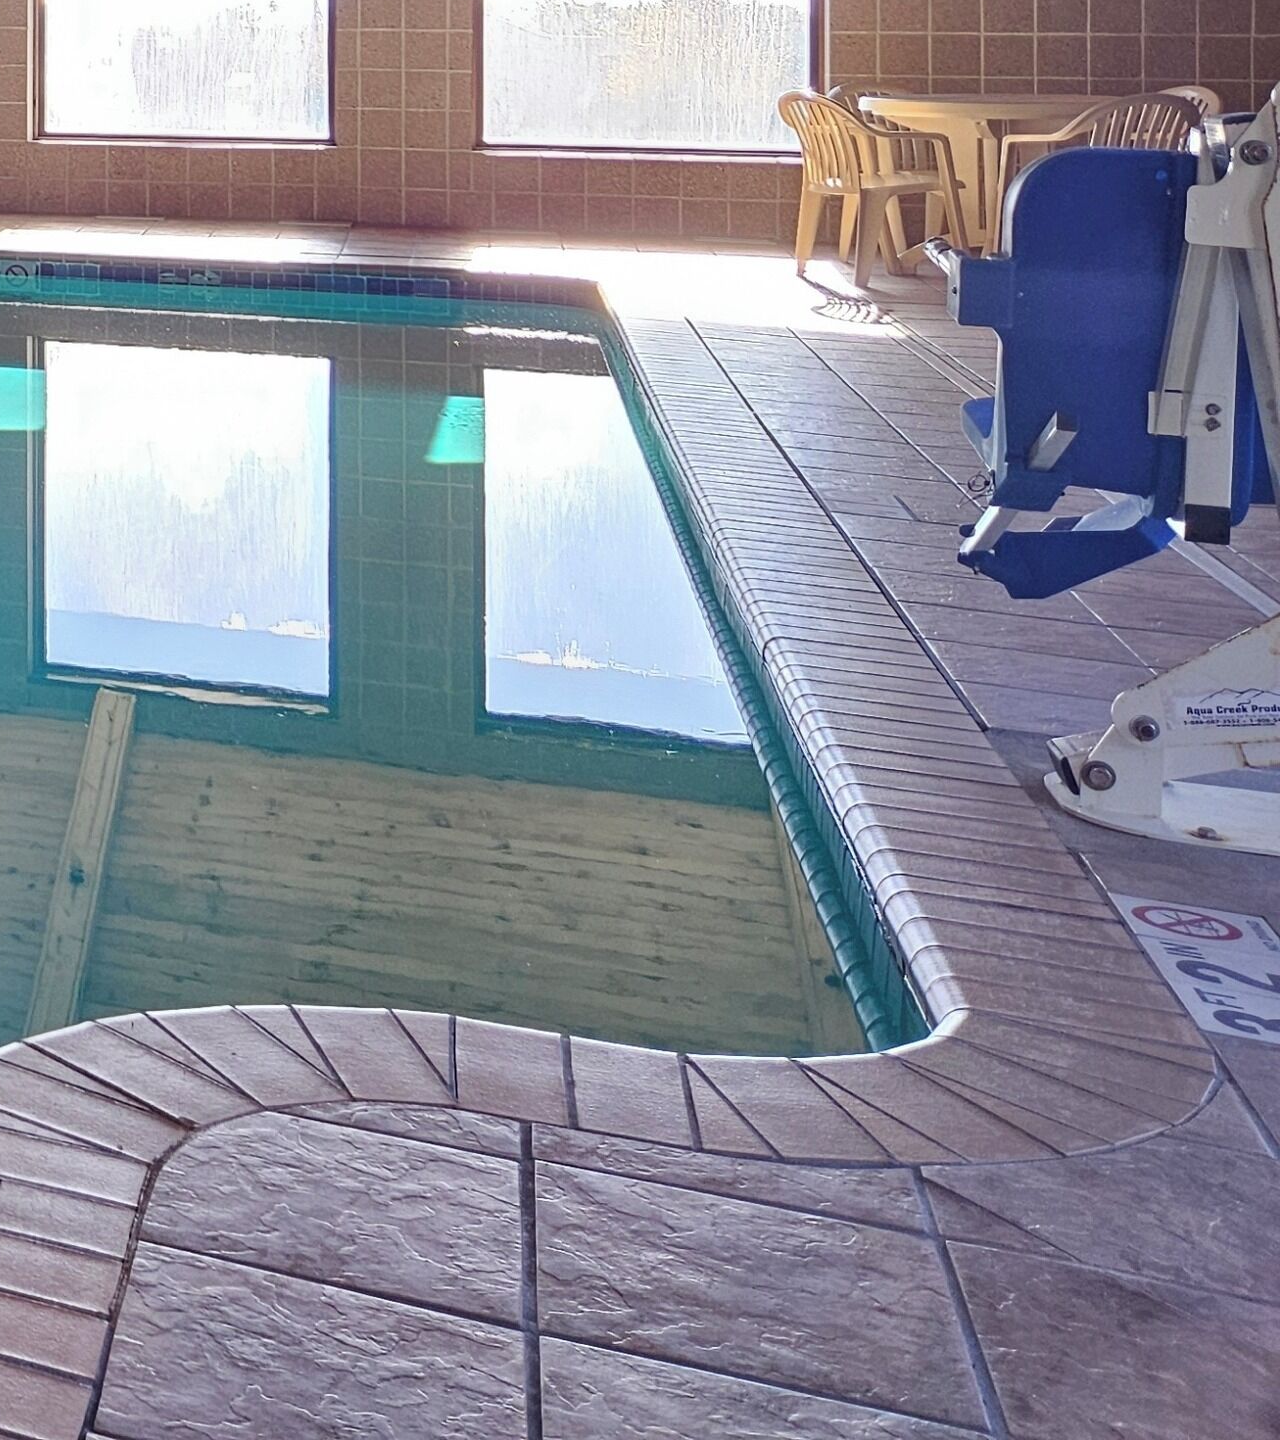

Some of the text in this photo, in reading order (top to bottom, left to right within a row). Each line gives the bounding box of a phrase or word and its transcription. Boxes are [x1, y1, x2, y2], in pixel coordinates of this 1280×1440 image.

[1186, 706, 1213, 716] Aqua
[1216, 705, 1248, 714] Creek
[1159, 941, 1206, 960] IN
[1193, 987, 1246, 1010] FT
